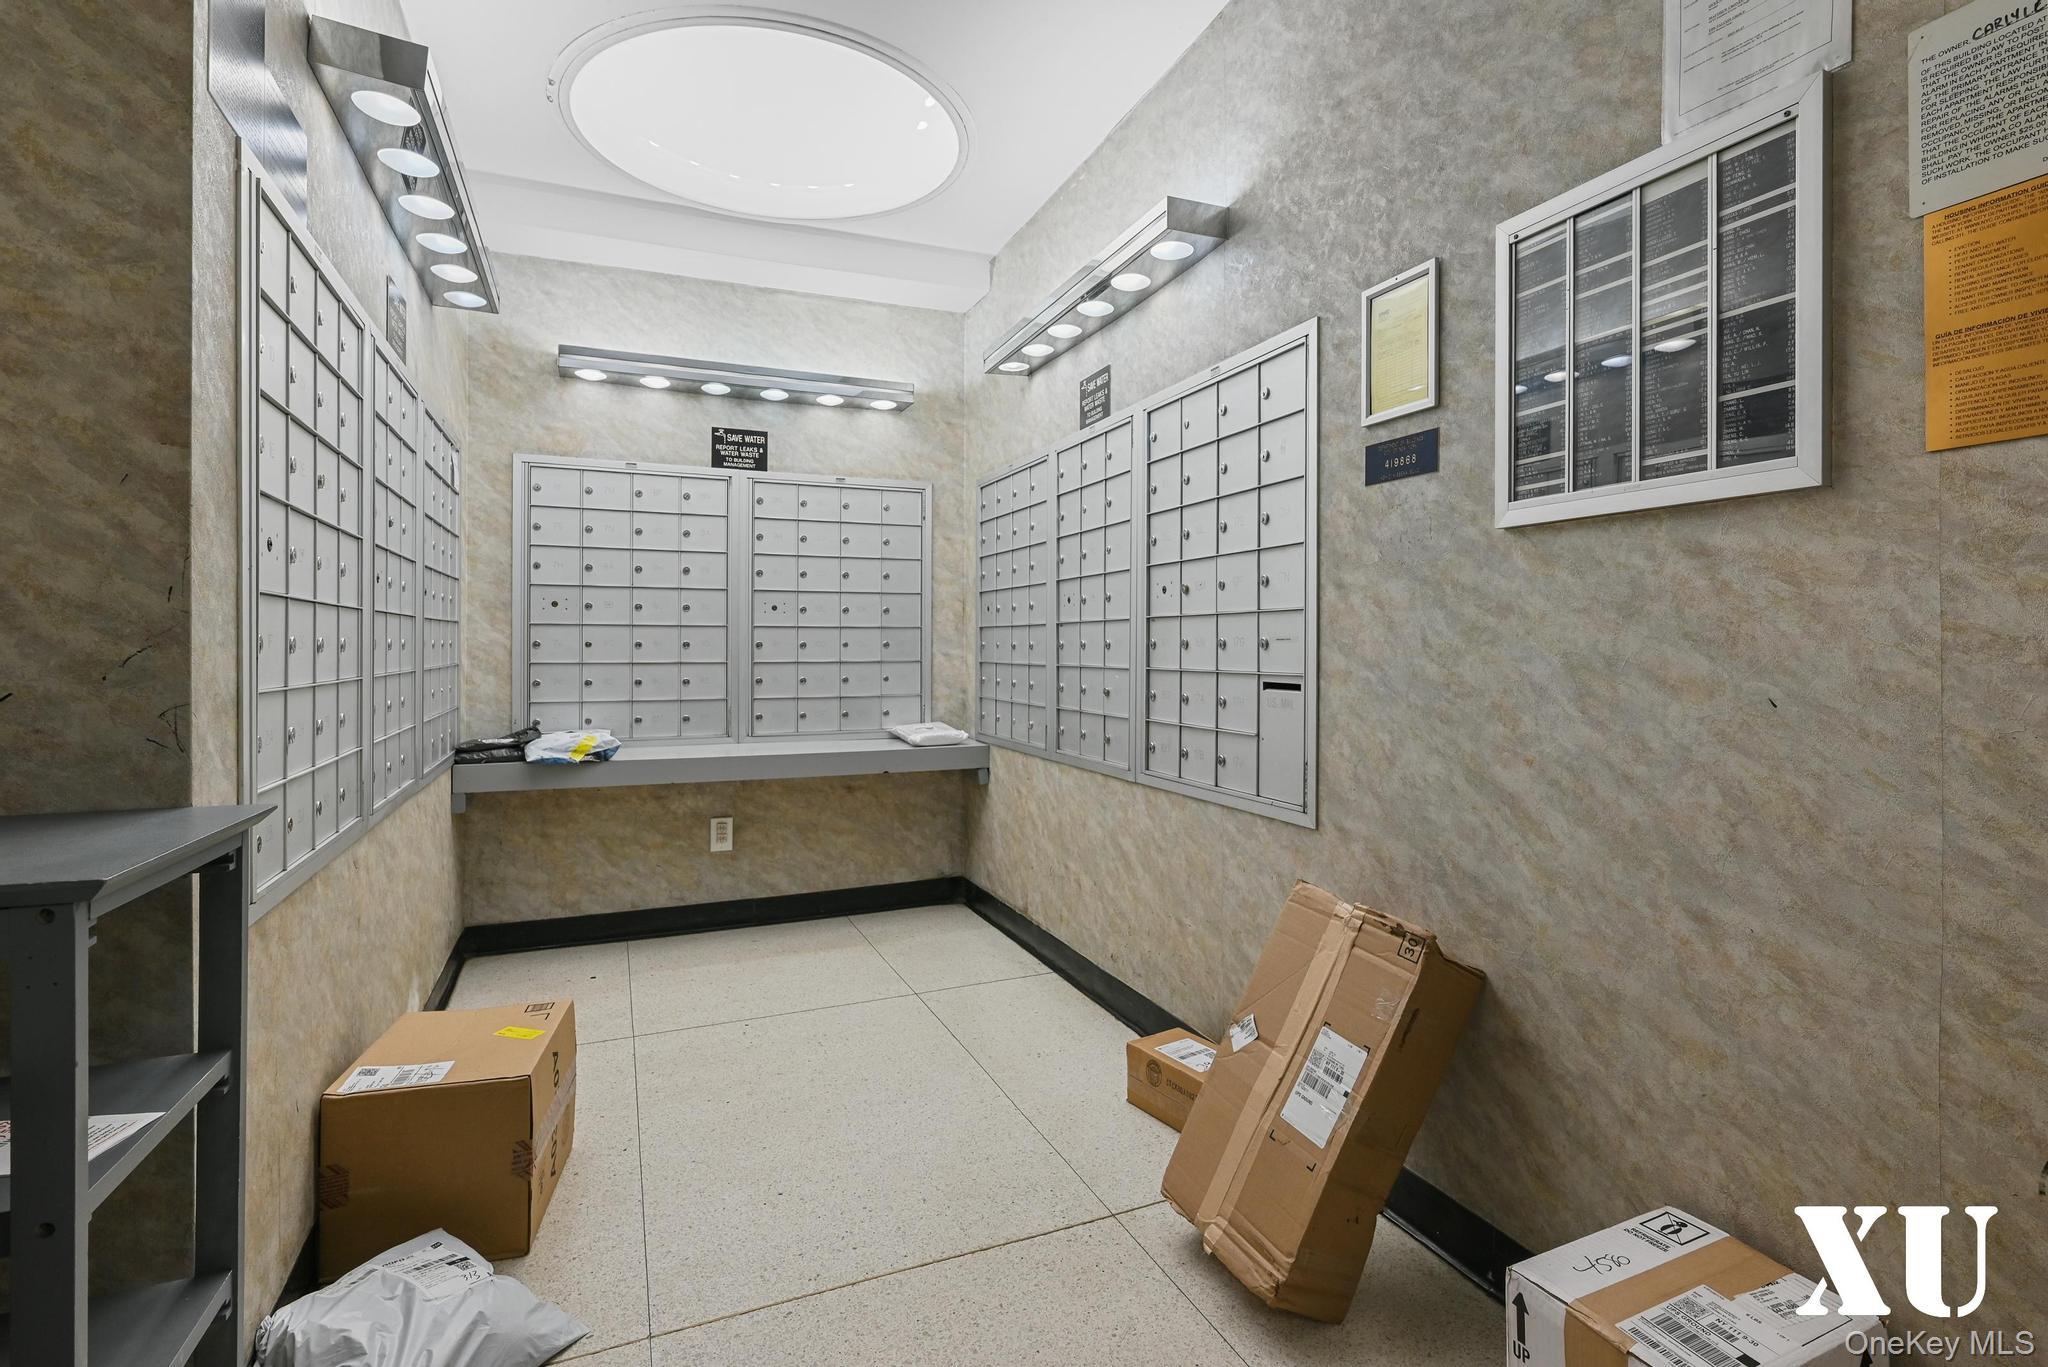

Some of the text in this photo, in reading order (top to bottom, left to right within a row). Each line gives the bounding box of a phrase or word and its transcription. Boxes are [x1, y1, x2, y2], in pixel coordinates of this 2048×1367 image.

[1921, 15, 2047, 77] OF THIS BUILDING LOCATED AT
[1921, 23, 2045, 84] IS REQUIRED BY LAW TO POST
[1922, 53, 1936, 65] THE
[1921, 82, 1948, 98] ALARM
[1950, 78, 1957, 86] IN
[1959, 67, 1982, 82] EACH
[1984, 43, 2036, 71] APARTMENT
[1921, 96, 1932, 106] OF
[1935, 89, 1949, 100] THE
[1952, 72, 1988, 93] PRIMARY
[1991, 51, 2038, 76] ENTRANCE
[1921, 101, 1937, 113] FOR
[1984, 74, 2000, 86] THE
[2003, 66, 2021, 79] LAW
[1922, 78, 1940, 91] THAT
[1944, 69, 1959, 81] THE
[1961, 55, 1992, 73] OWNER
[1995, 50, 2002, 59] IS
[1921, 106, 1942, 120] EACH
[1945, 85, 1994, 110] APARTMENT
[1921, 111, 1949, 127] REPAIR
[1952, 105, 1963, 115] OF
[1966, 98, 1981, 109] THE
[1984, 82, 2018, 102] ALARMS
[1922, 123, 1937, 134] FOR
[1939, 103, 1985, 127] REPLACING
[1988, 96, 2005, 108] ANY
[2008, 89, 2021, 100] OR
[2024, 81, 2040, 93] ALL
[2004, 99, 2016, 109] OR
[1922, 125, 1971, 149] OCCUPANCY
[1974, 119, 1985, 129] OF
[1987, 112, 2004, 123] THE
[1922, 144, 1941, 156] THAT
[1944, 137, 1959, 148] THE
[1962, 118, 2007, 141] OCCUPANT
[2010, 112, 2022, 122] OF
[1922, 145, 1958, 163] BUILDING
[1960, 141, 1967, 149] IN
[1970, 130, 1998, 145] WHICH
[2000, 126, 2006, 134] A
[2009, 120, 2022, 130] CO
[1922, 119, 2046, 171] SHALL PAY THE OWNER $25.00
[1922, 165, 1944, 178] SUCH
[1975, 147, 1991, 158] THE
[1993, 129, 2041, 152] OCCUPANT
[1922, 176, 1933, 185] OF
[1934, 155, 1990, 181] INSTALLATION
[1993, 151, 2003, 160] TO
[2006, 141, 2030, 155] MAKE
[1945, 205, 1976, 220] HOUSING
[1978, 188, 2029, 209] INFORMATION
[2018, 313, 2028, 321] DE
[727, 434, 766, 444] SAVE WATER
[1384, 454, 1416, 468] 419868
[1405, 938, 1418, 957] 30
[1666, 1305, 1712, 1336] UPS GROUND
[1513, 1340, 1530, 1363] UP
